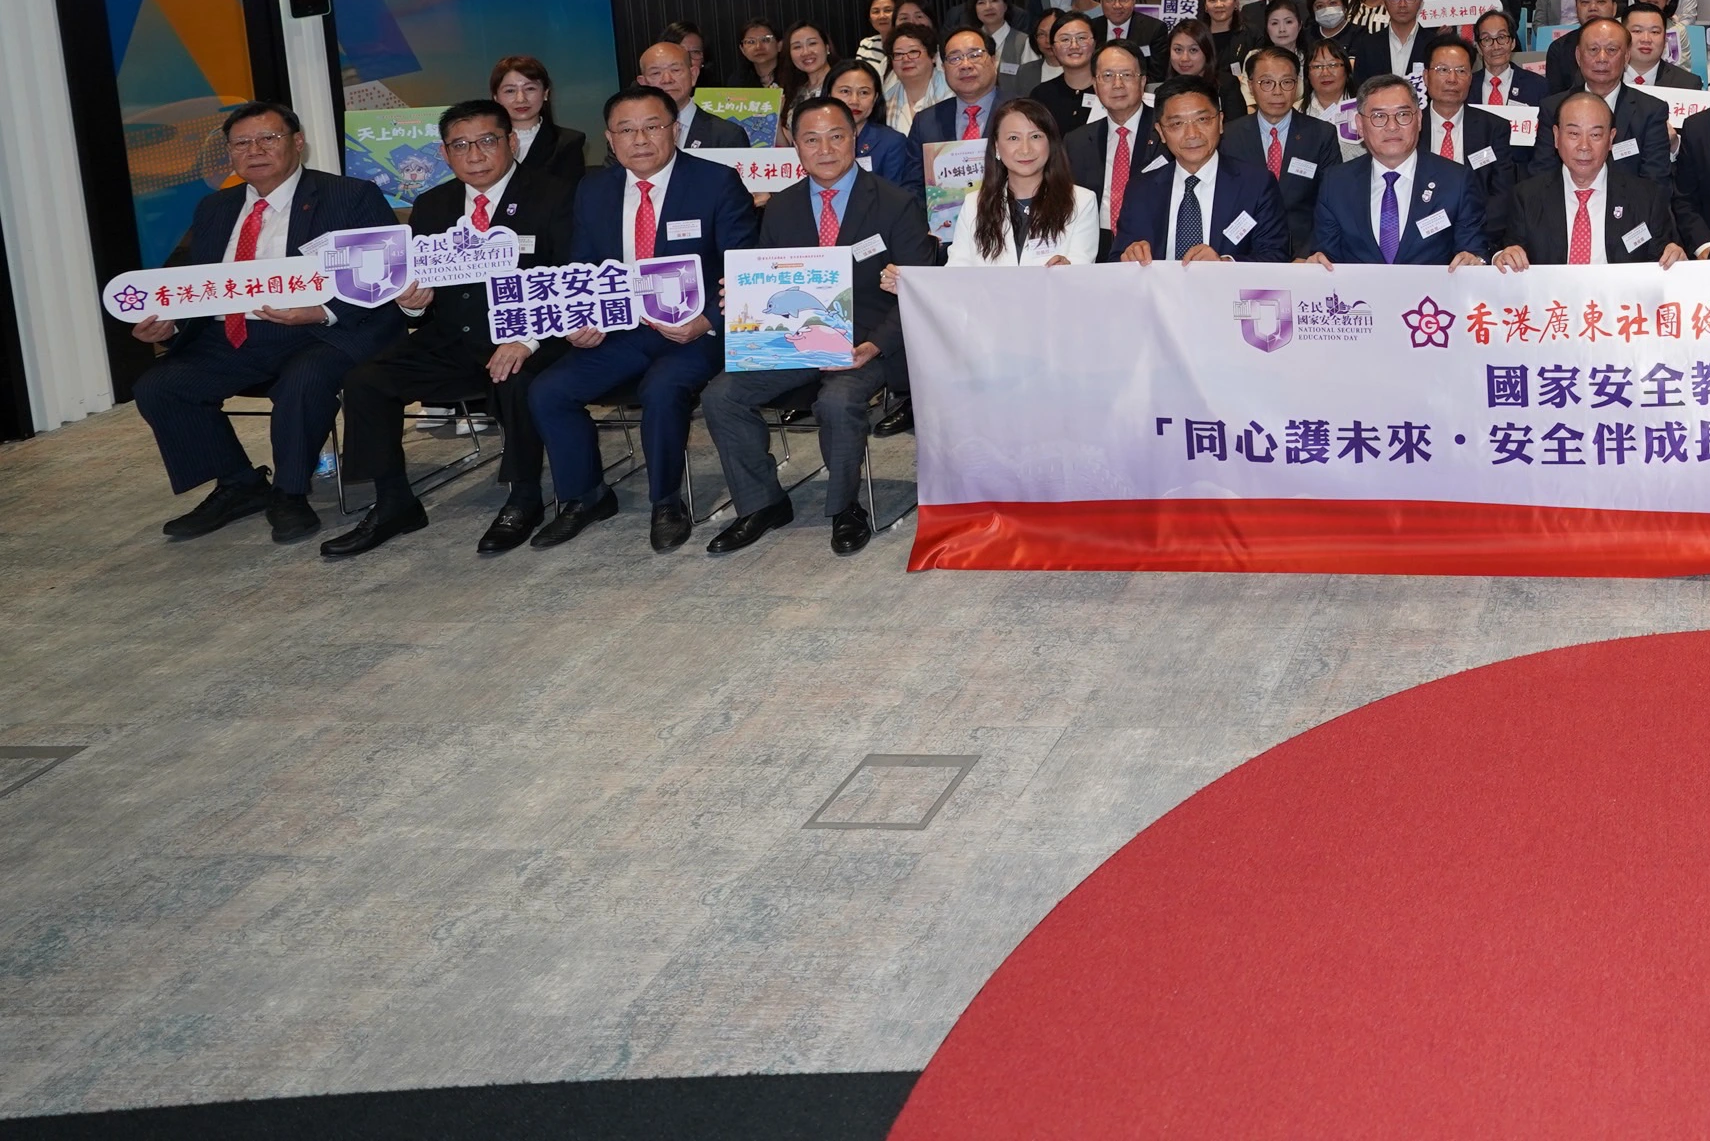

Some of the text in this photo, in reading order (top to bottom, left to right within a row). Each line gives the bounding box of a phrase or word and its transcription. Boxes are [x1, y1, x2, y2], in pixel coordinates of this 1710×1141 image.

[415, 238, 448, 253] 全民
[413, 247, 514, 268] 國家安全教育日
[414, 260, 512, 276] NATIONAL SECURITY
[491, 264, 630, 306] 國家安全
[737, 269, 840, 285] 我們的藍色海洋
[154, 271, 330, 307] 香港廣東社團總會
[1297, 301, 1323, 314] 全民
[493, 297, 634, 340] 護我家園
[1297, 315, 1373, 326] 國家安全教育日
